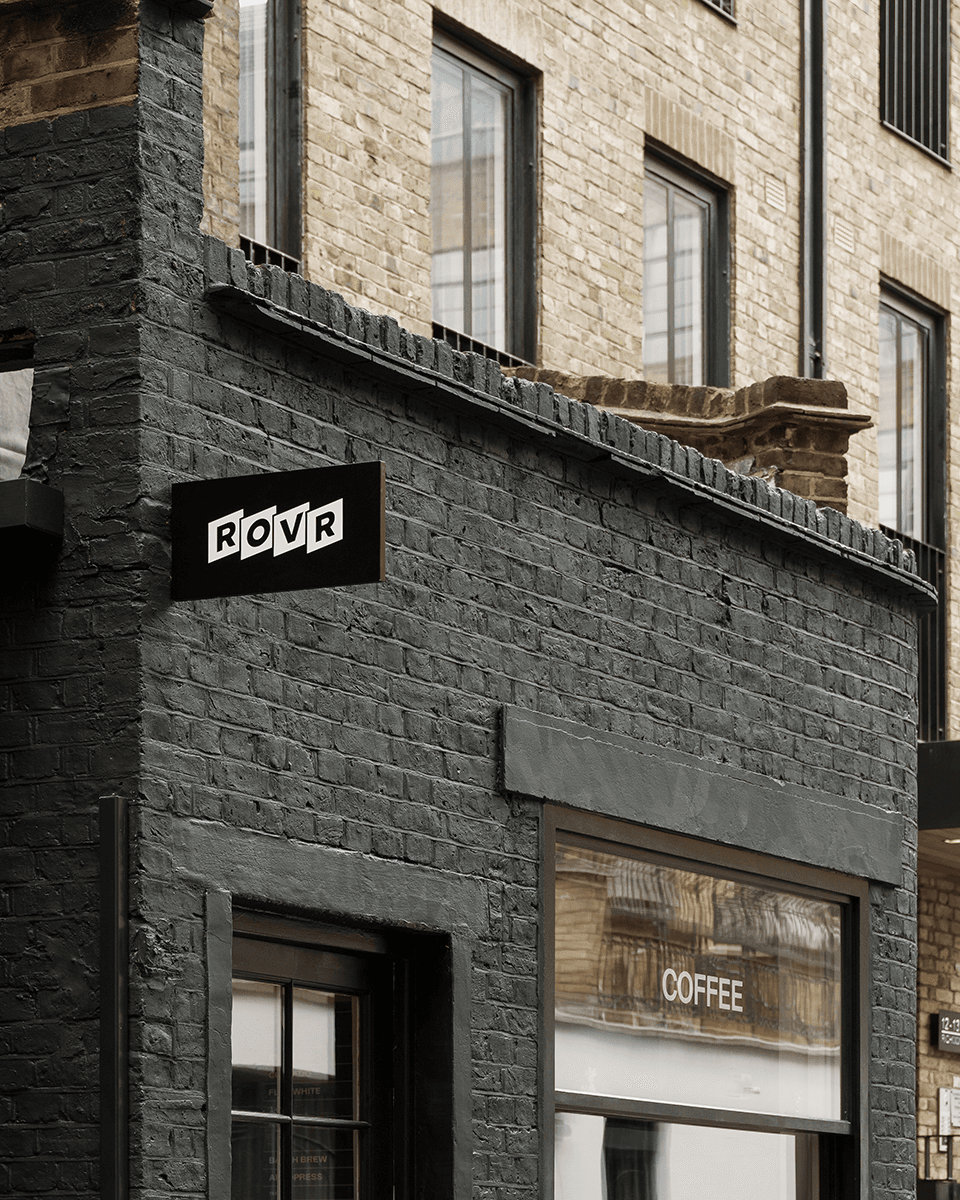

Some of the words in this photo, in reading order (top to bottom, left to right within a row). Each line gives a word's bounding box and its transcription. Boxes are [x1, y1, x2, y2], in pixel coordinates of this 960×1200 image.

[214, 508, 338, 555] ROVR
[662, 968, 744, 1012] COFFEE
[292, 1087, 320, 1095] WHITE
[300, 1155, 328, 1163] BREW
